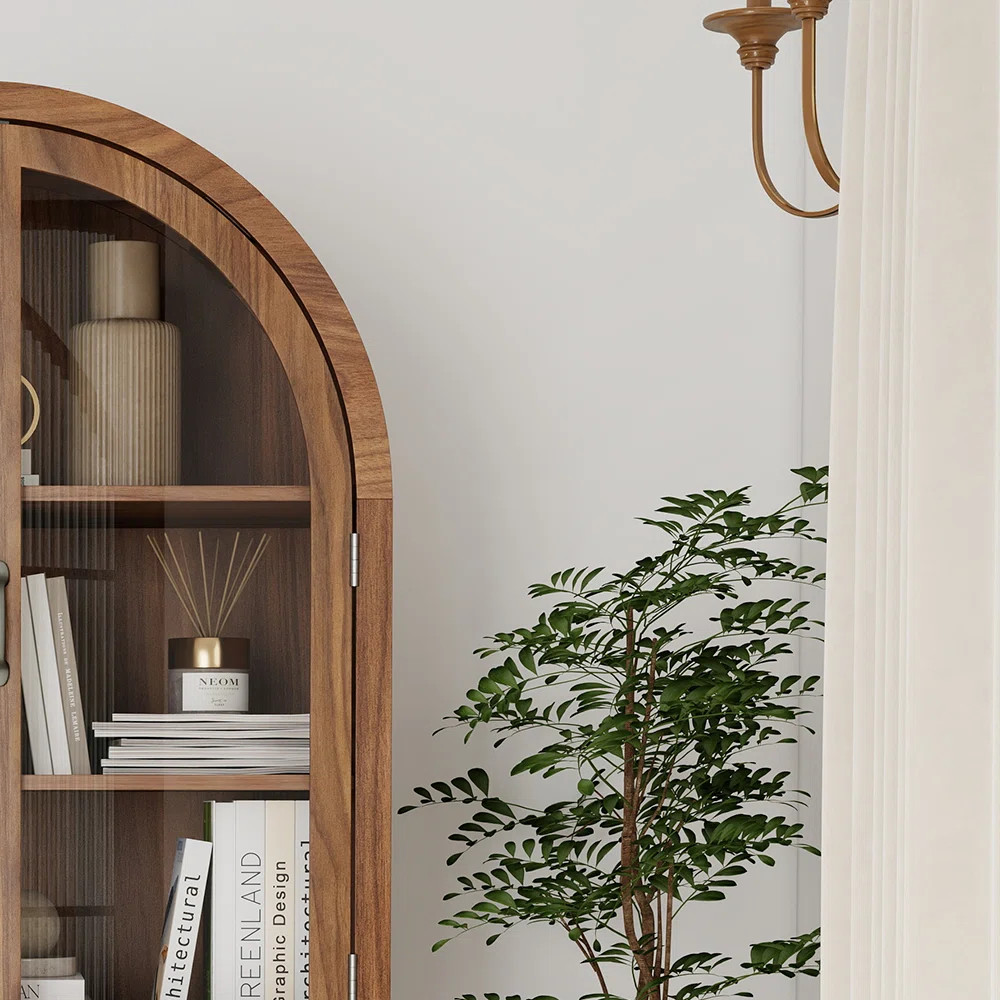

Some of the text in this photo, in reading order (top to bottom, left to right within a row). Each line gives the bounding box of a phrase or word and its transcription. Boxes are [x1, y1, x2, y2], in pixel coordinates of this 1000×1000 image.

[65, 668, 76, 708] MADELEINE
[71, 711, 81, 742] LEMAIRE
[200, 678, 239, 686] NEOM
[273, 861, 290, 926] Design
